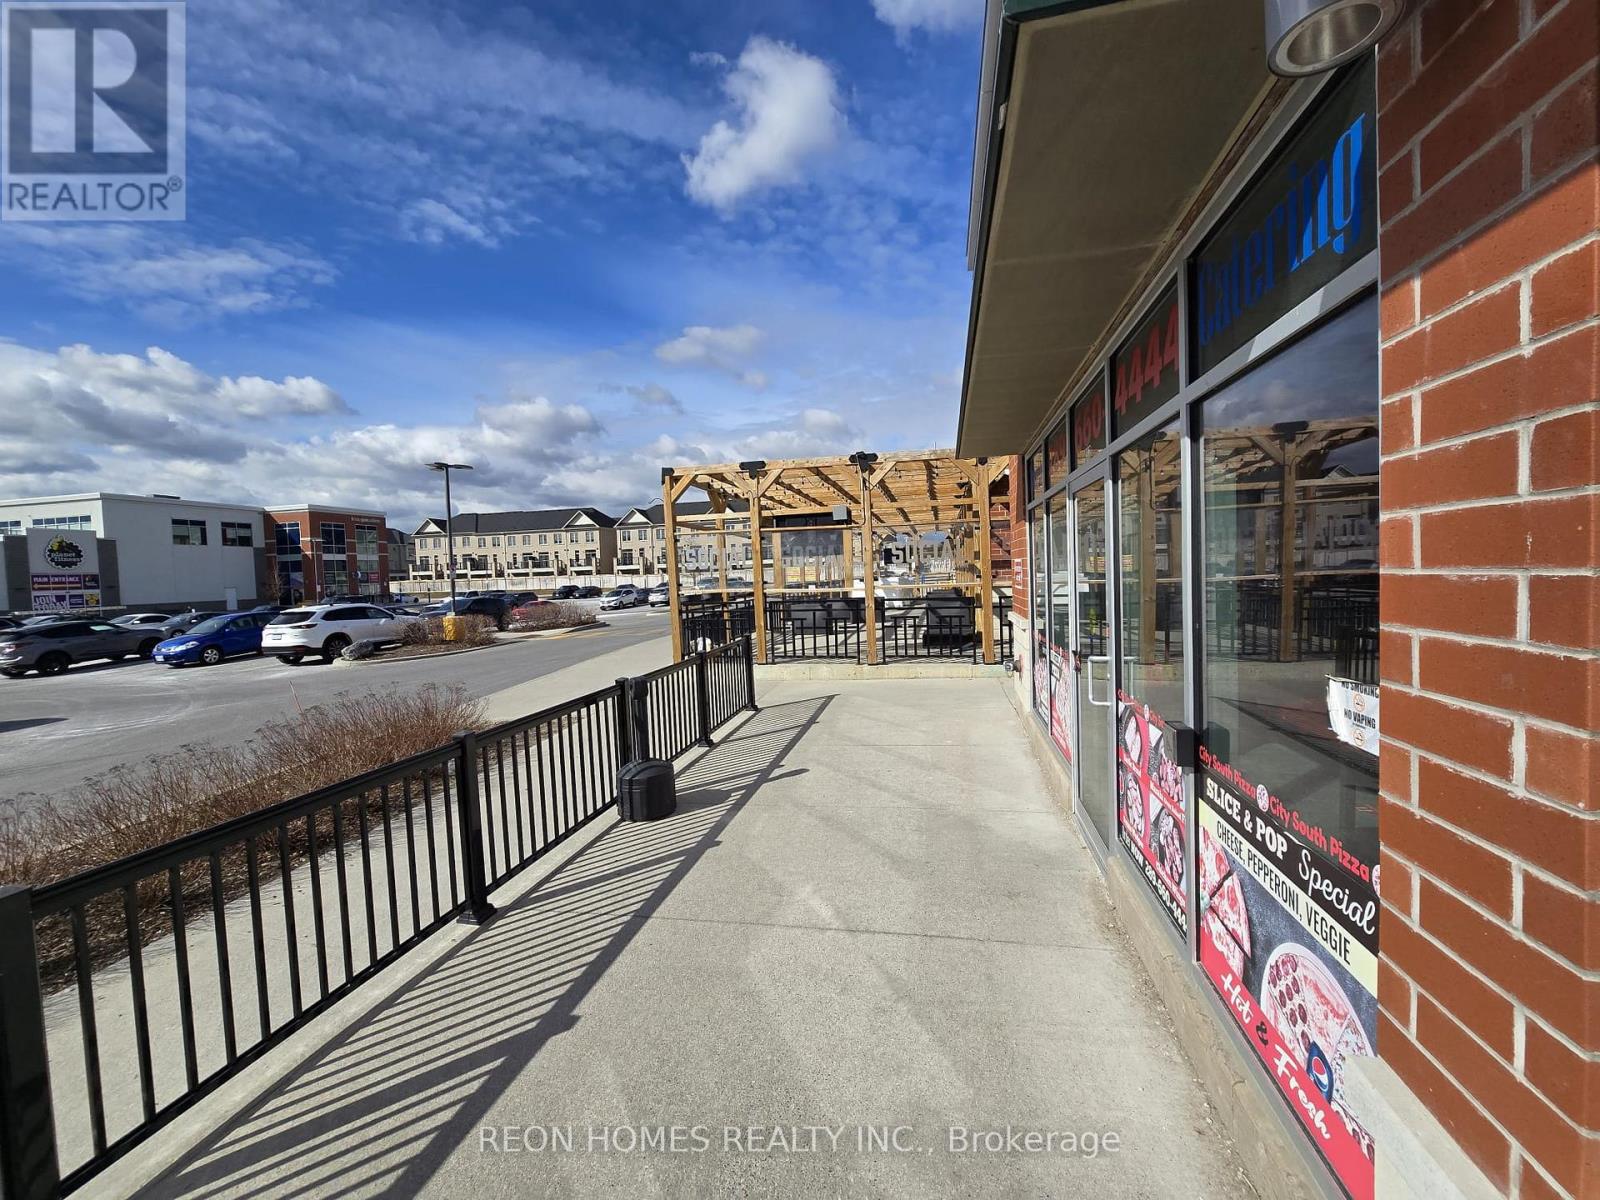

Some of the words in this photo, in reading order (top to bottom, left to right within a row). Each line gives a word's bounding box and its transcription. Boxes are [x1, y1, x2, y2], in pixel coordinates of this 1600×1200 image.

[1199, 113, 1367, 346] Catering
[1115, 304, 1179, 415] 4444
[1199, 745, 1212, 768] City
[1212, 754, 1233, 781] South
[1234, 769, 1256, 800] Pizza
[1344, 708, 1352, 720] NO
[1353, 711, 1376, 729] VAPING
[1206, 777, 1241, 823] SLICE
[1243, 809, 1253, 833] &
[1256, 816, 1288, 860] POP
[1299, 849, 1376, 936] Special
[1216, 820, 1246, 865] CHEESE,
[1247, 845, 1302, 921] PEPPERONI,
[1305, 901, 1352, 966] VEGGIE
[1269, 795, 1290, 828] City
[1292, 811, 1327, 852] South
[1330, 835, 1370, 883] Pizza
[1221, 973, 1254, 1024] Hot
[1273, 1044, 1330, 1140] Fresh
